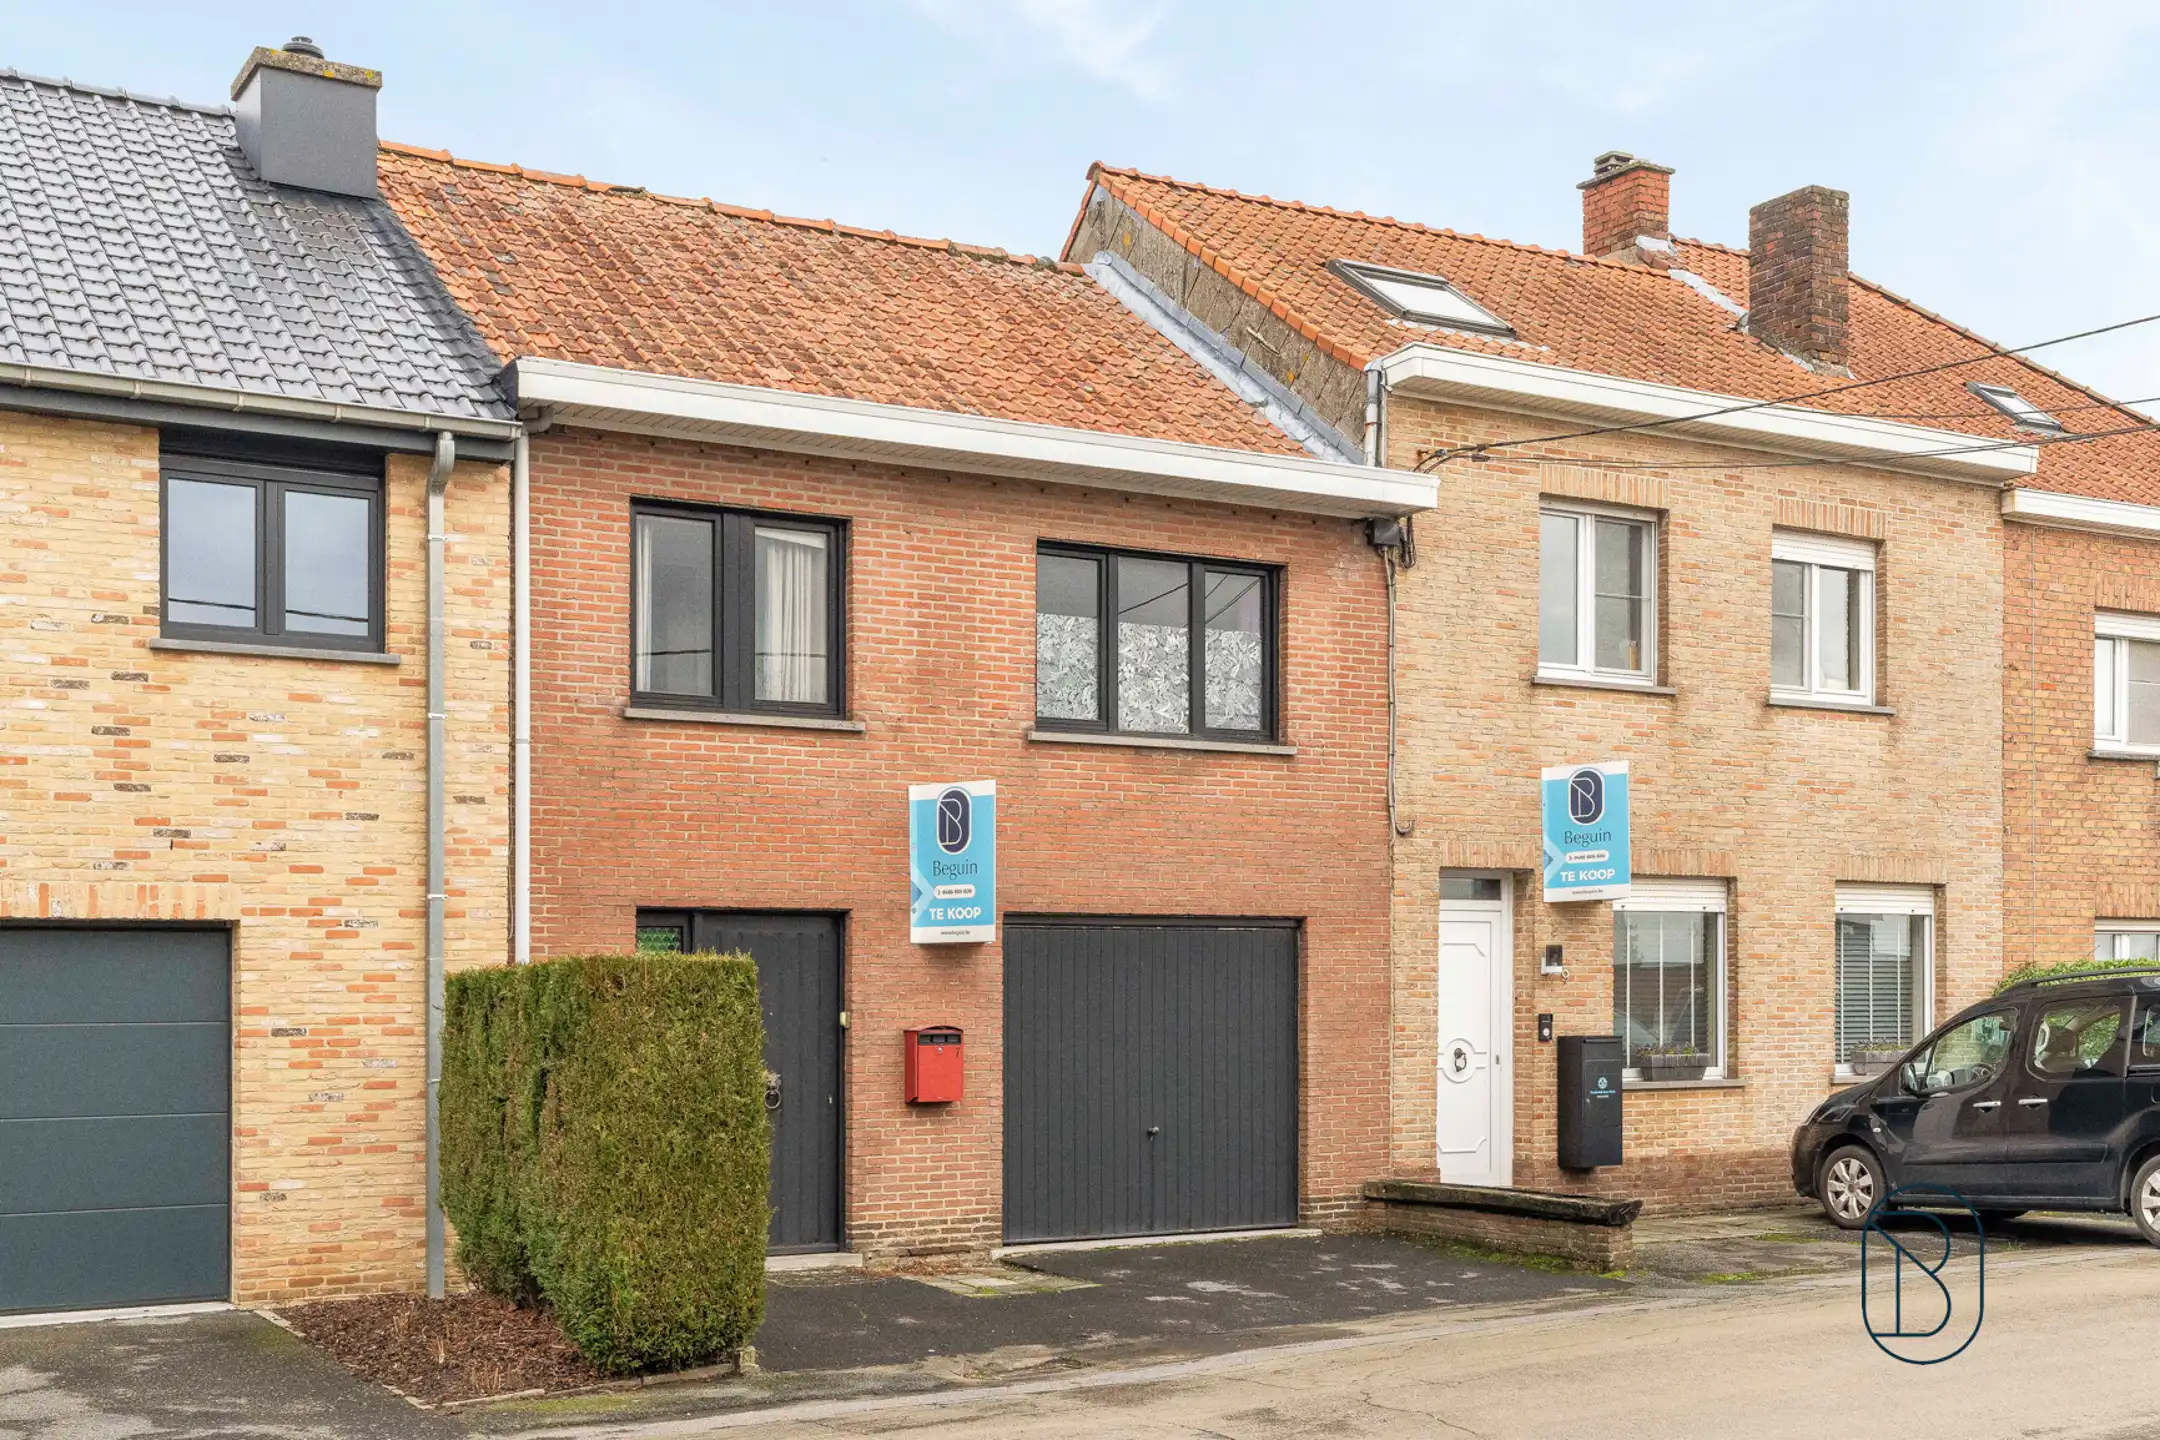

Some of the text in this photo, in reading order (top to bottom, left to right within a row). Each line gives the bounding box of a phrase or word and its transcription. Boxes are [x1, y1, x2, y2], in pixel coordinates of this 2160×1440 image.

[1564, 828, 1612, 847] Beguin
[932, 859, 978, 880] Beguin
[1560, 868, 1616, 882] TE KOOP
[929, 906, 982, 920] TE KOOP
